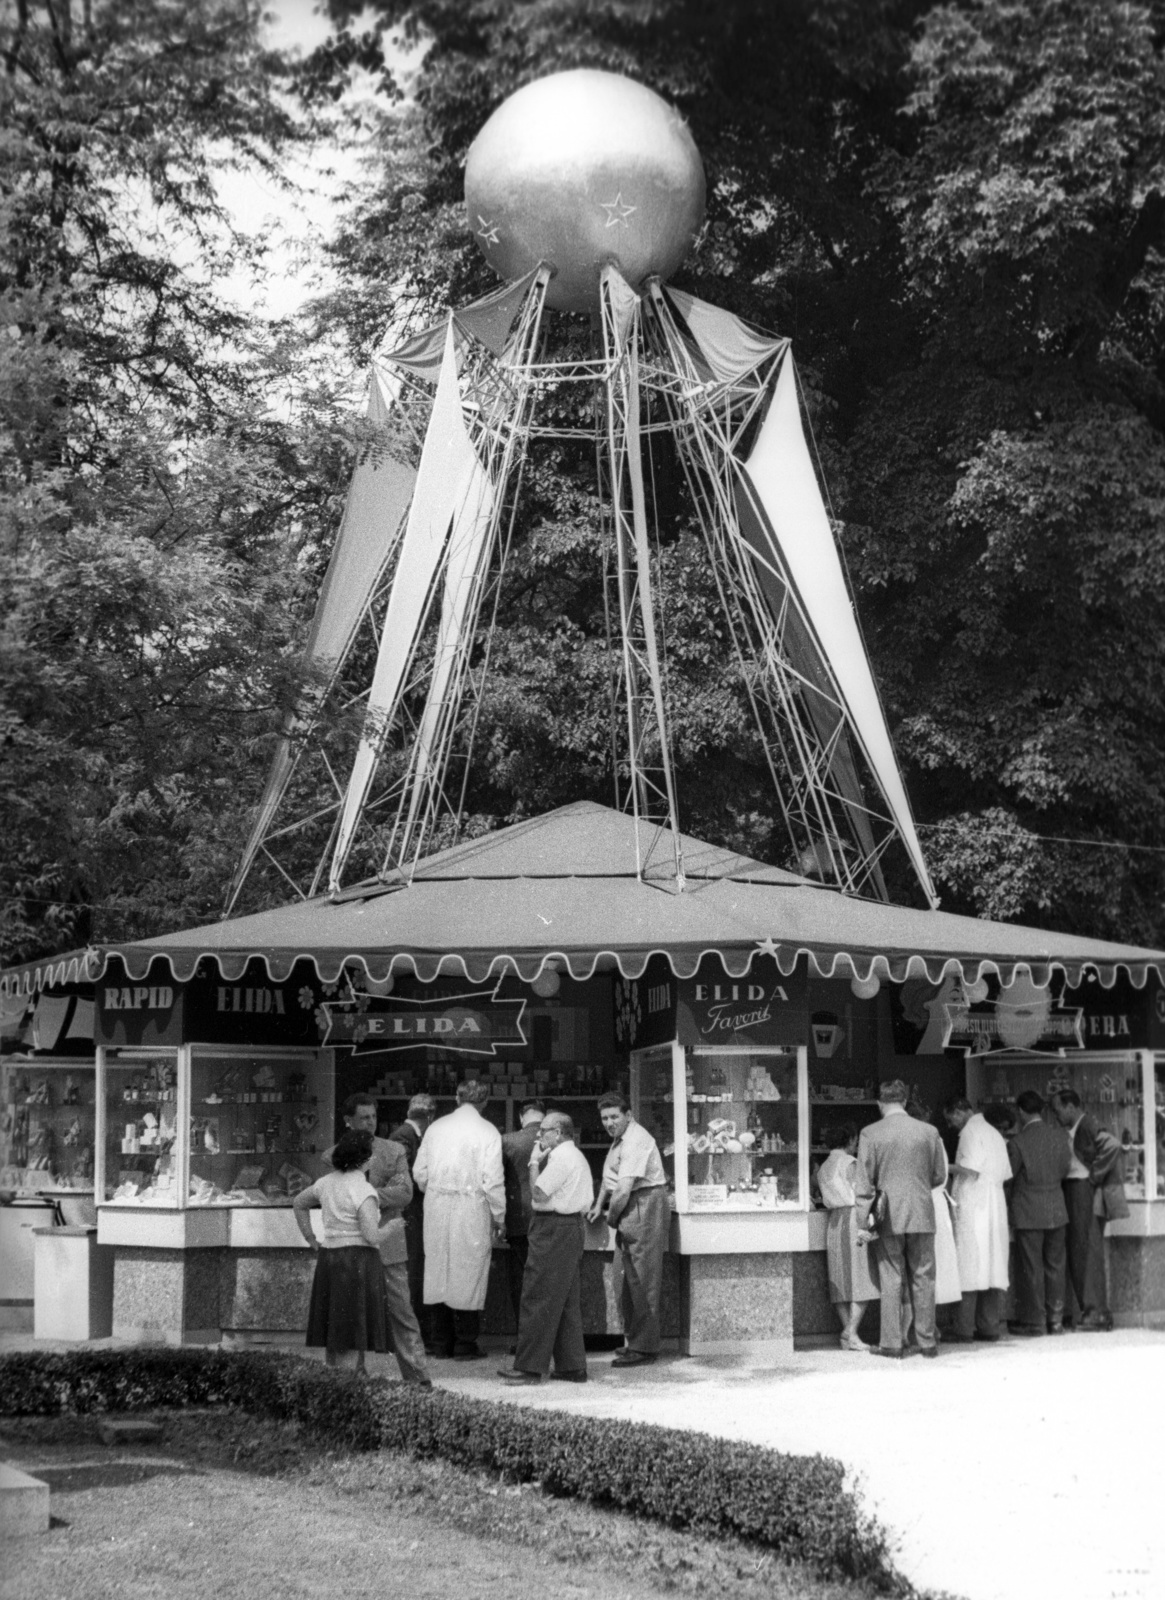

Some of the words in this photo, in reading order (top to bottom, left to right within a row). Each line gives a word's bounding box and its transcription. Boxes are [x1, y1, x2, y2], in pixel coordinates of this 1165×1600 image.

[104, 986, 174, 1010] RAPID
[217, 986, 286, 1015] ELIDA
[695, 984, 790, 1001] ELIDA
[367, 1017, 481, 1033] ELIDA
[702, 1003, 771, 1033] Favorit
